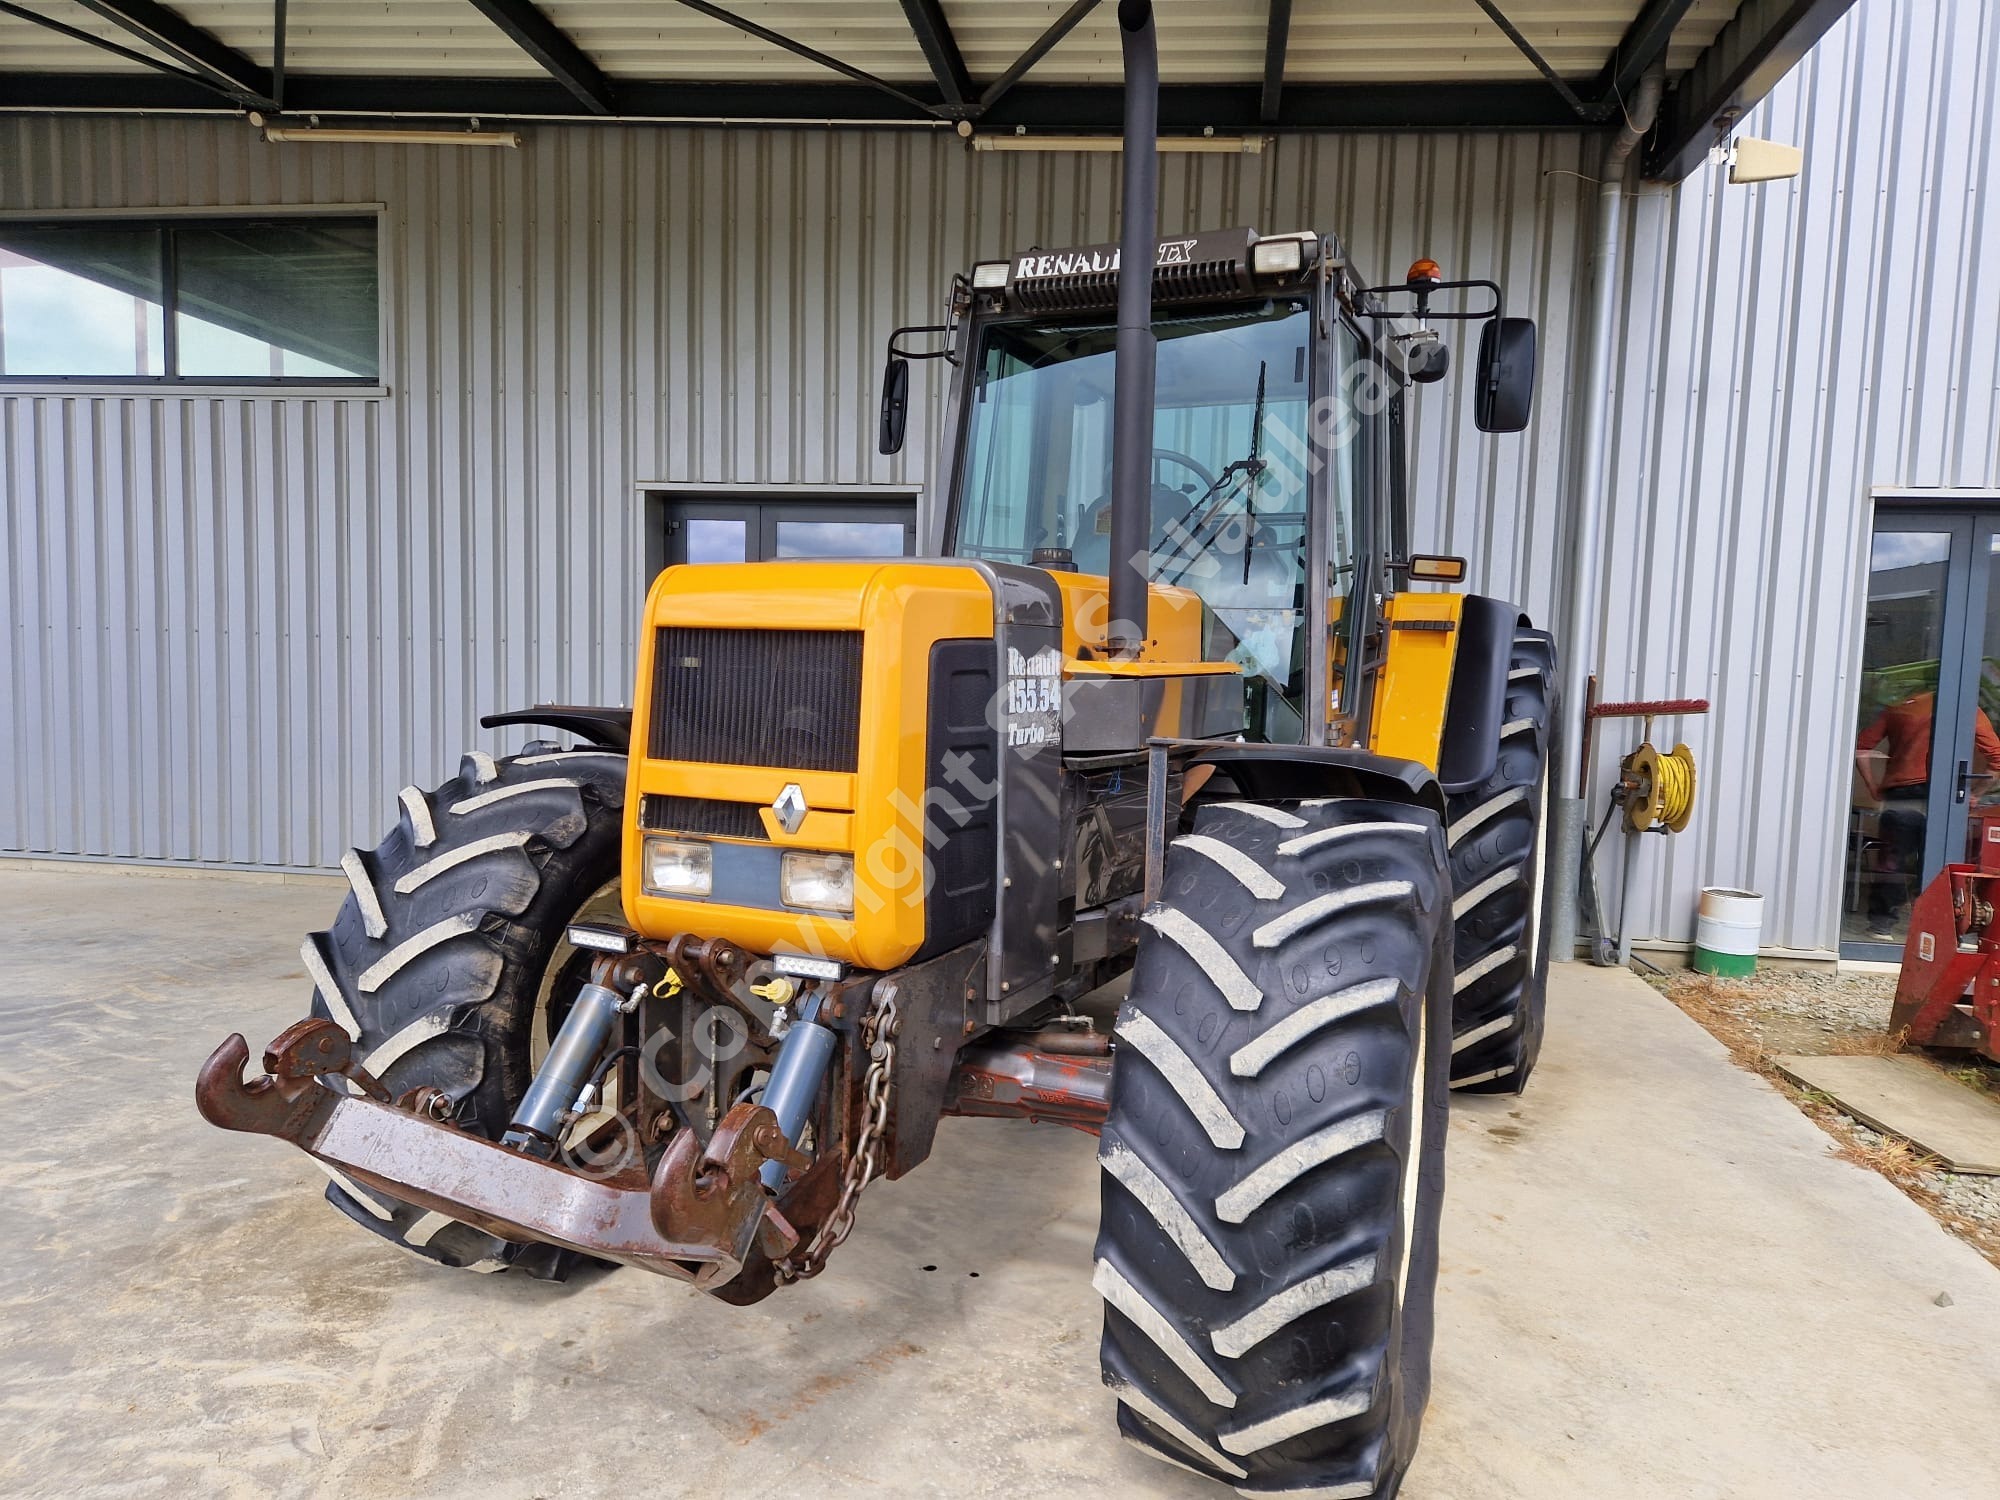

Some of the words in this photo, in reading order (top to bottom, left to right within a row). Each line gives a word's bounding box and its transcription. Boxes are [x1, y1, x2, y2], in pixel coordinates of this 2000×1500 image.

[1015, 248, 1121, 279] RENAU
[1156, 239, 1198, 265] TX
[1007, 646, 1061, 676] Renault
[1007, 678, 1061, 714] 155.54
[1007, 722, 1045, 747] Turbo
